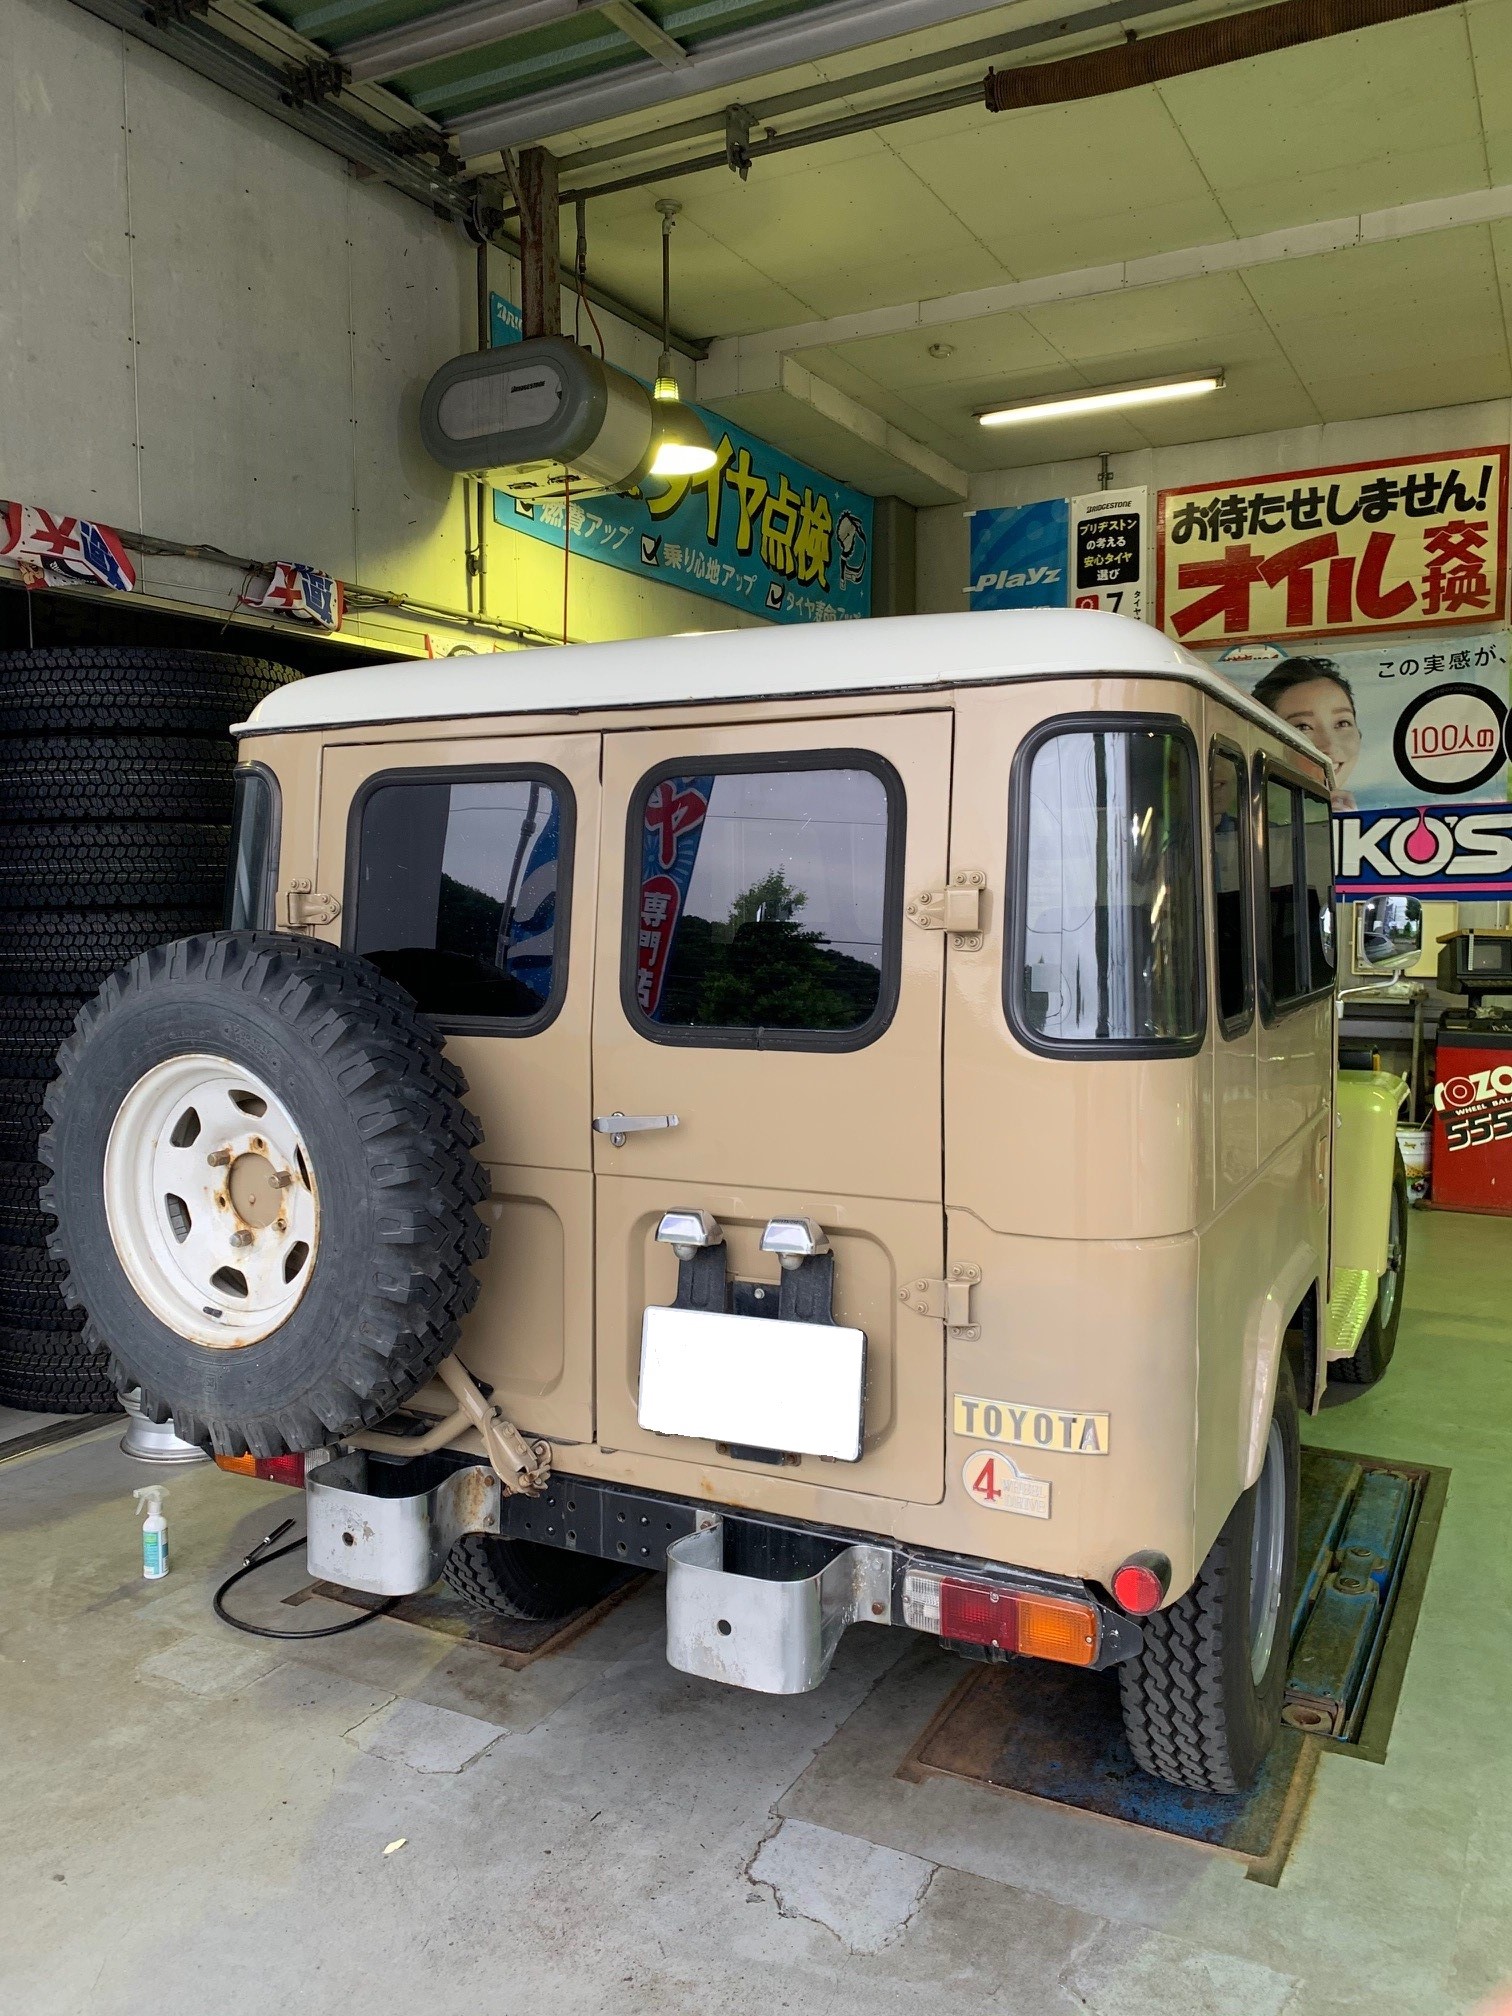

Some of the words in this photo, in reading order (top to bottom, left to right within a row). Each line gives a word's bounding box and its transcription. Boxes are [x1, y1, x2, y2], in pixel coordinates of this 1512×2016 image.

[1086, 500, 1132, 513] BRIDGESTONE
[1171, 465, 1493, 544] お待たせしません!
[1079, 519, 1138, 536] ブリヂストン
[1086, 536, 1126, 550] の考える
[663, 542, 758, 596] 乗り心地アップ
[1083, 551, 1133, 568] 安心タイヤ
[1096, 568, 1121, 582] 選び
[1411, 724, 1495, 755] 100人の
[1455, 1103, 1487, 1116] WHEEL
[1491, 1096, 1512, 1107] BAL
[961, 1400, 1101, 1451] TOYOTA
[972, 1457, 1002, 1502] 4
